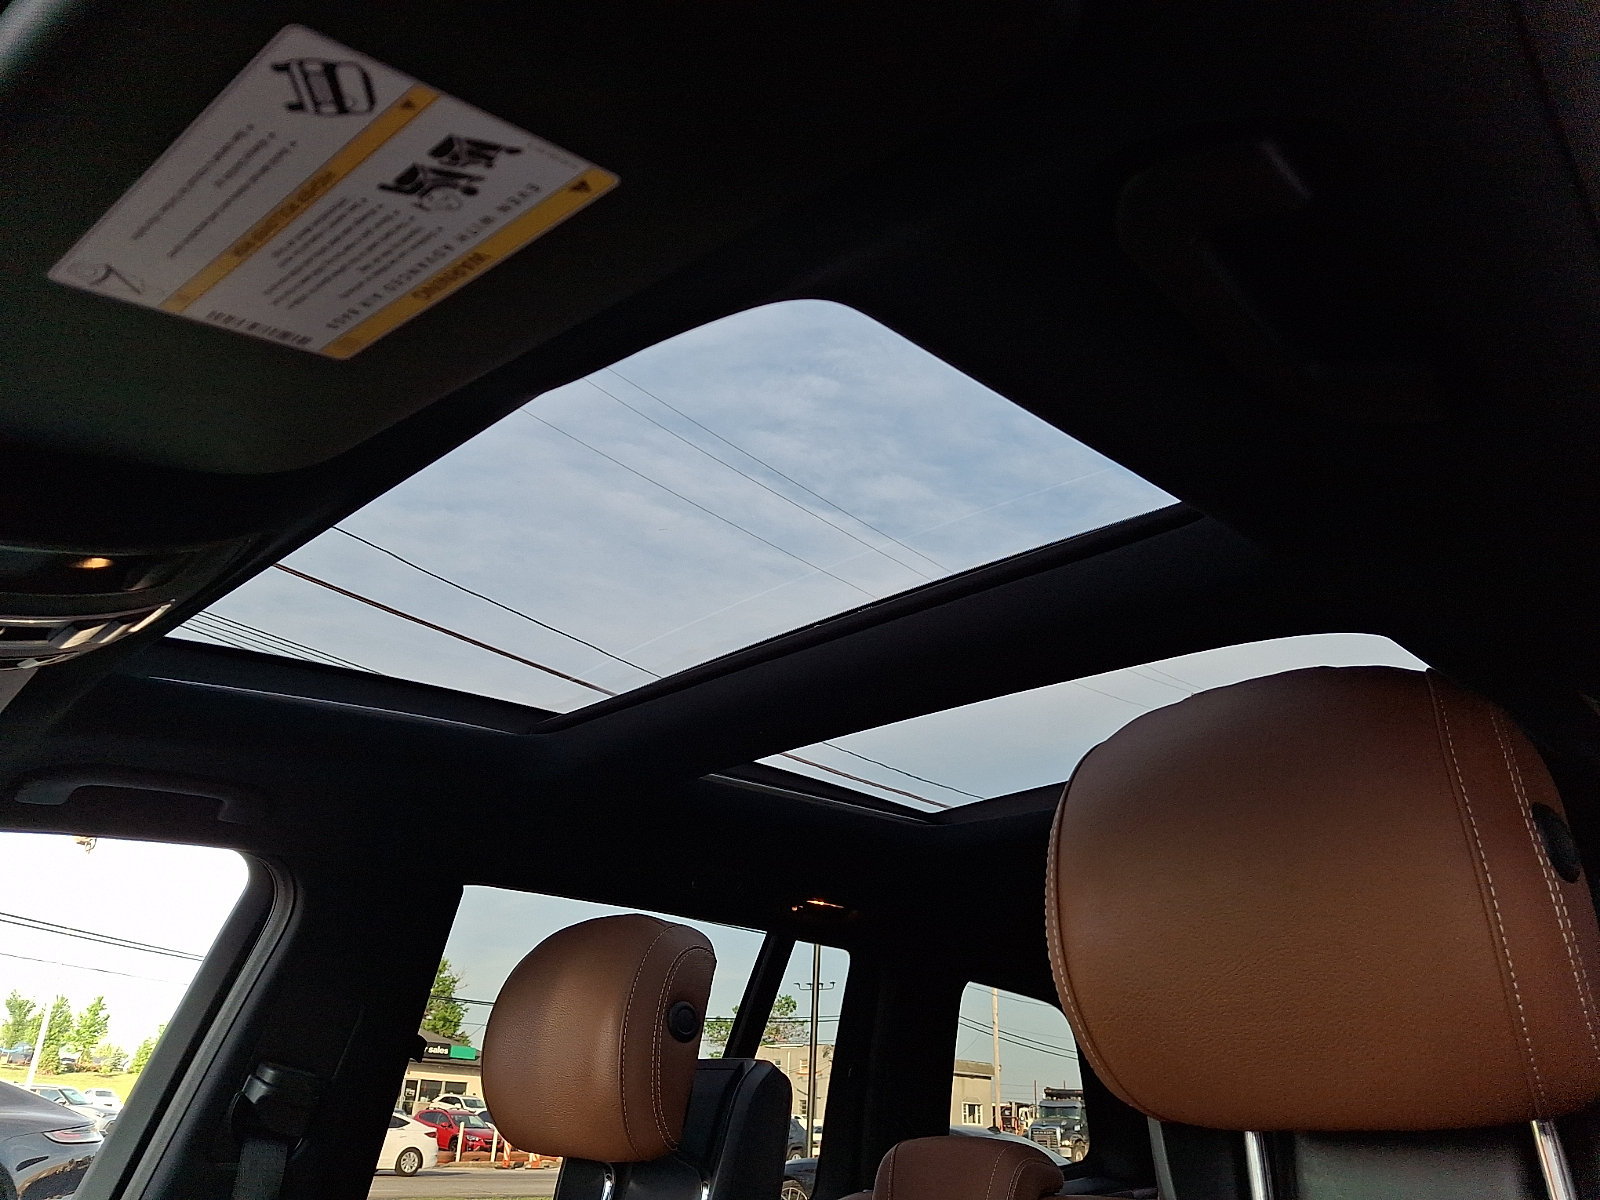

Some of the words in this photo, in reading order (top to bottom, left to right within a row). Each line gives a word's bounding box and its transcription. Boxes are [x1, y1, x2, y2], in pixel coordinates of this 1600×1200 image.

[496, 183, 540, 213] EVEN
[456, 215, 495, 242] WITH
[383, 243, 455, 291] ADVANCED
[428, 1046, 449, 1055] sales
